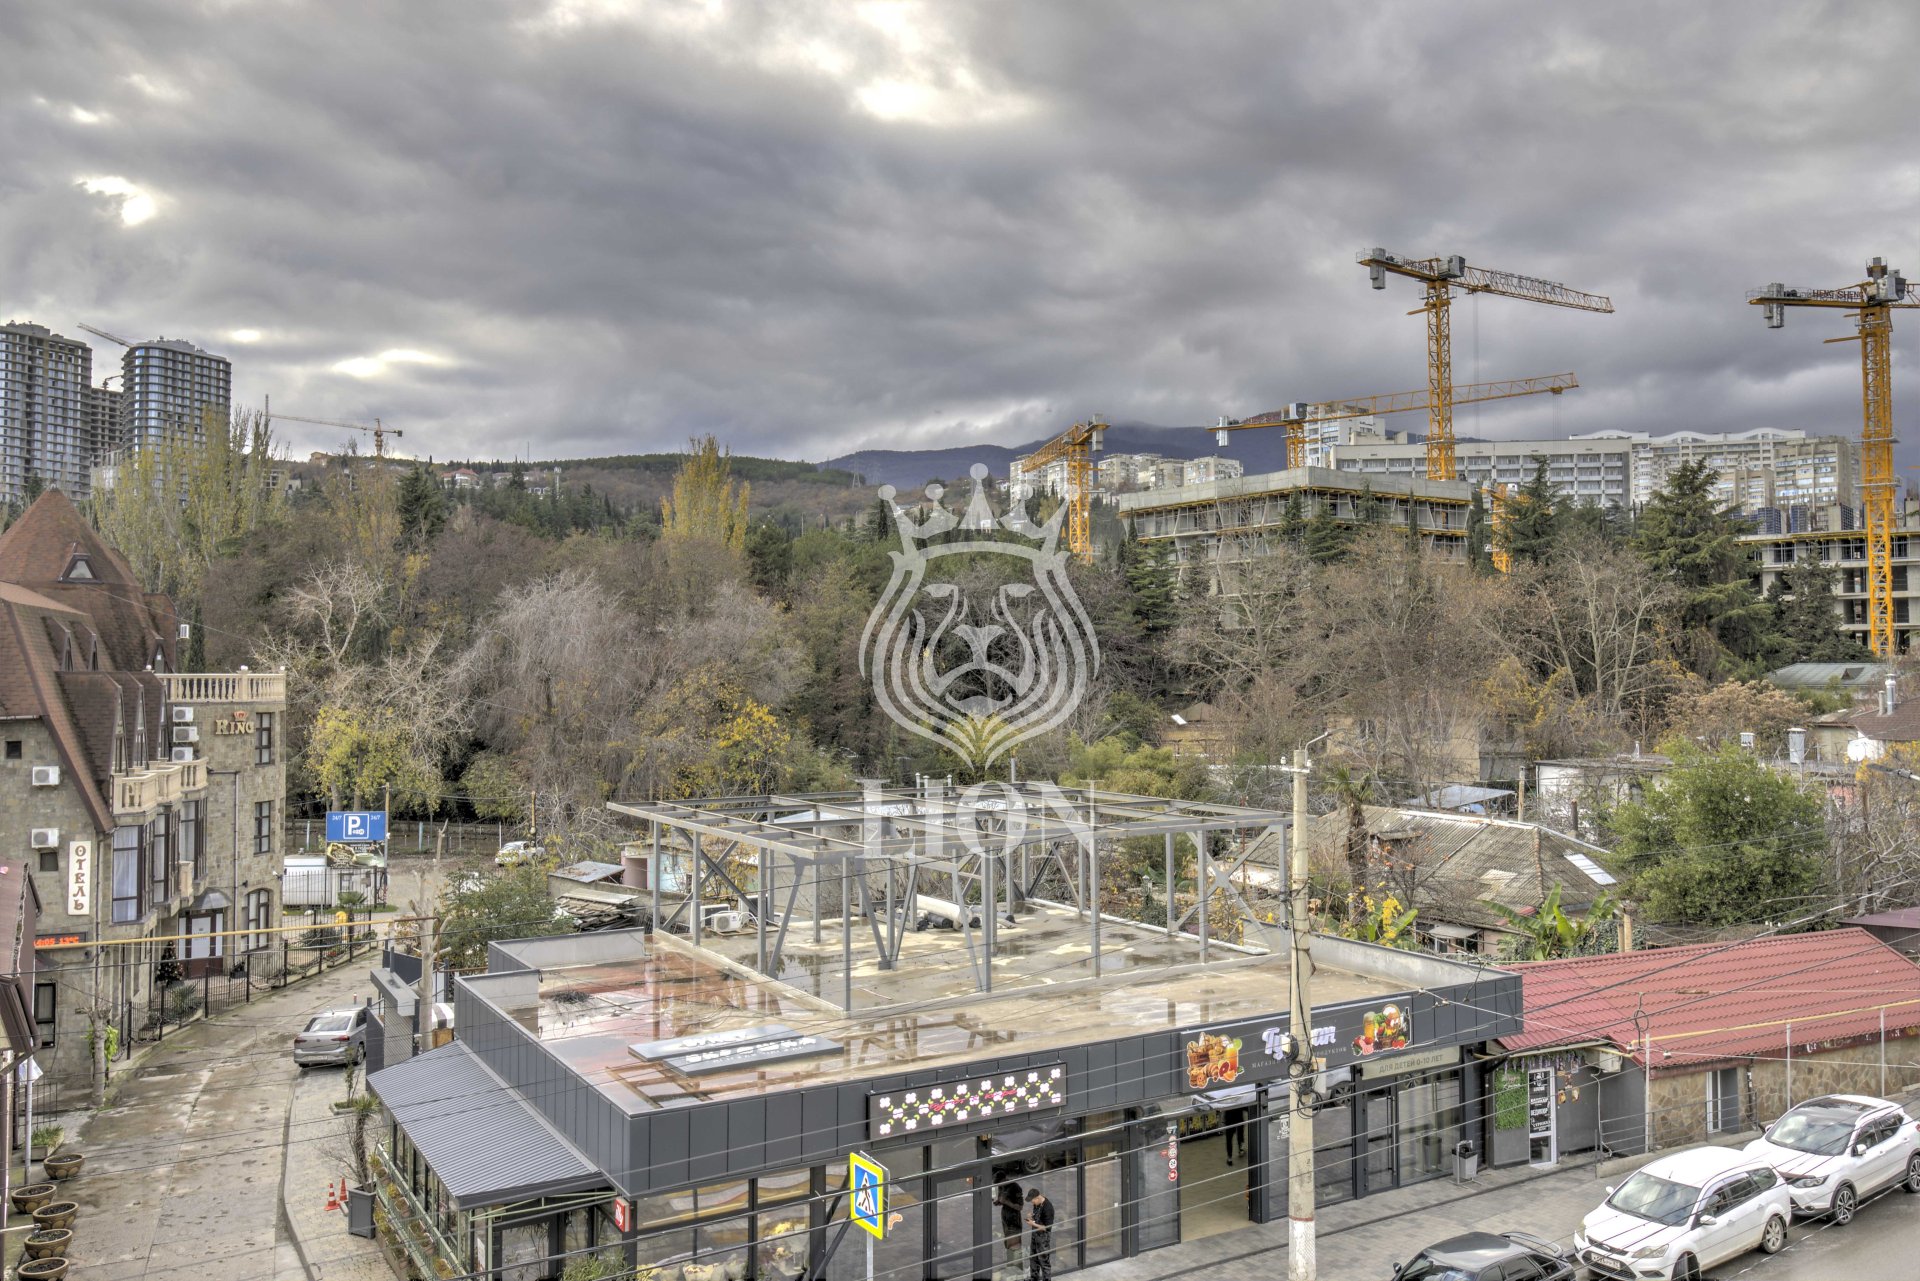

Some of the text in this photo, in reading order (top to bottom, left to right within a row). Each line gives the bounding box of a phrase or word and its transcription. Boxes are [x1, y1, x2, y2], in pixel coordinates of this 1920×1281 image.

[73, 845, 86, 911] ОТЕЛЬ
[1380, 1065, 1393, 1073] ДЛЯ
[1394, 1060, 1416, 1070] ДЕТЕЙ
[1416, 1057, 1429, 1065] 0-10
